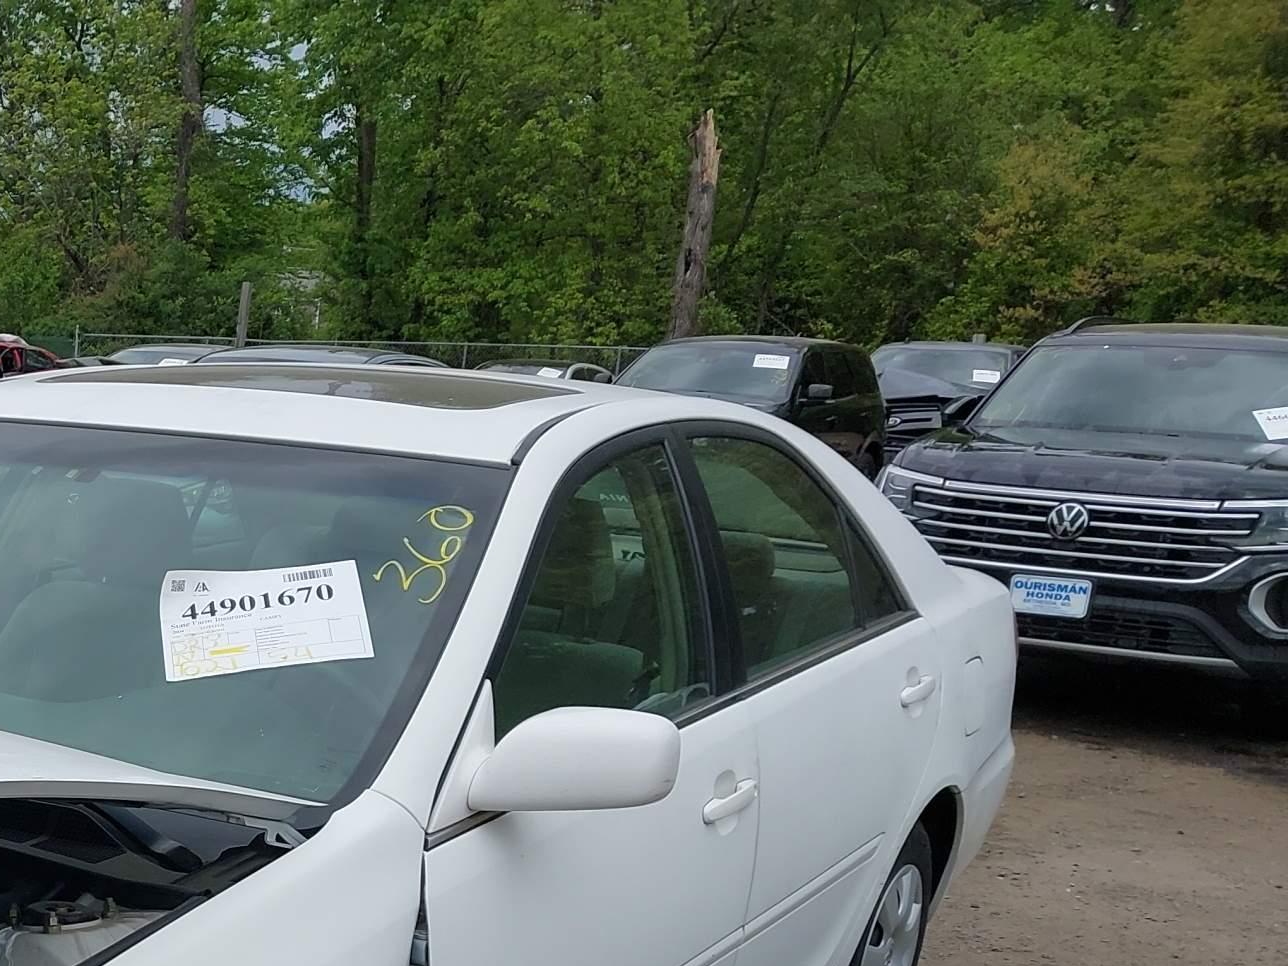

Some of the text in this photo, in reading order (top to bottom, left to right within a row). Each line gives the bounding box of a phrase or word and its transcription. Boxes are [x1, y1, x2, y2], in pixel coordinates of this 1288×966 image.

[372, 505, 475, 604] 360
[181, 583, 335, 621] 44901670
[1026, 591, 1071, 602] HONDA
[215, 613, 253, 623] Insurance
